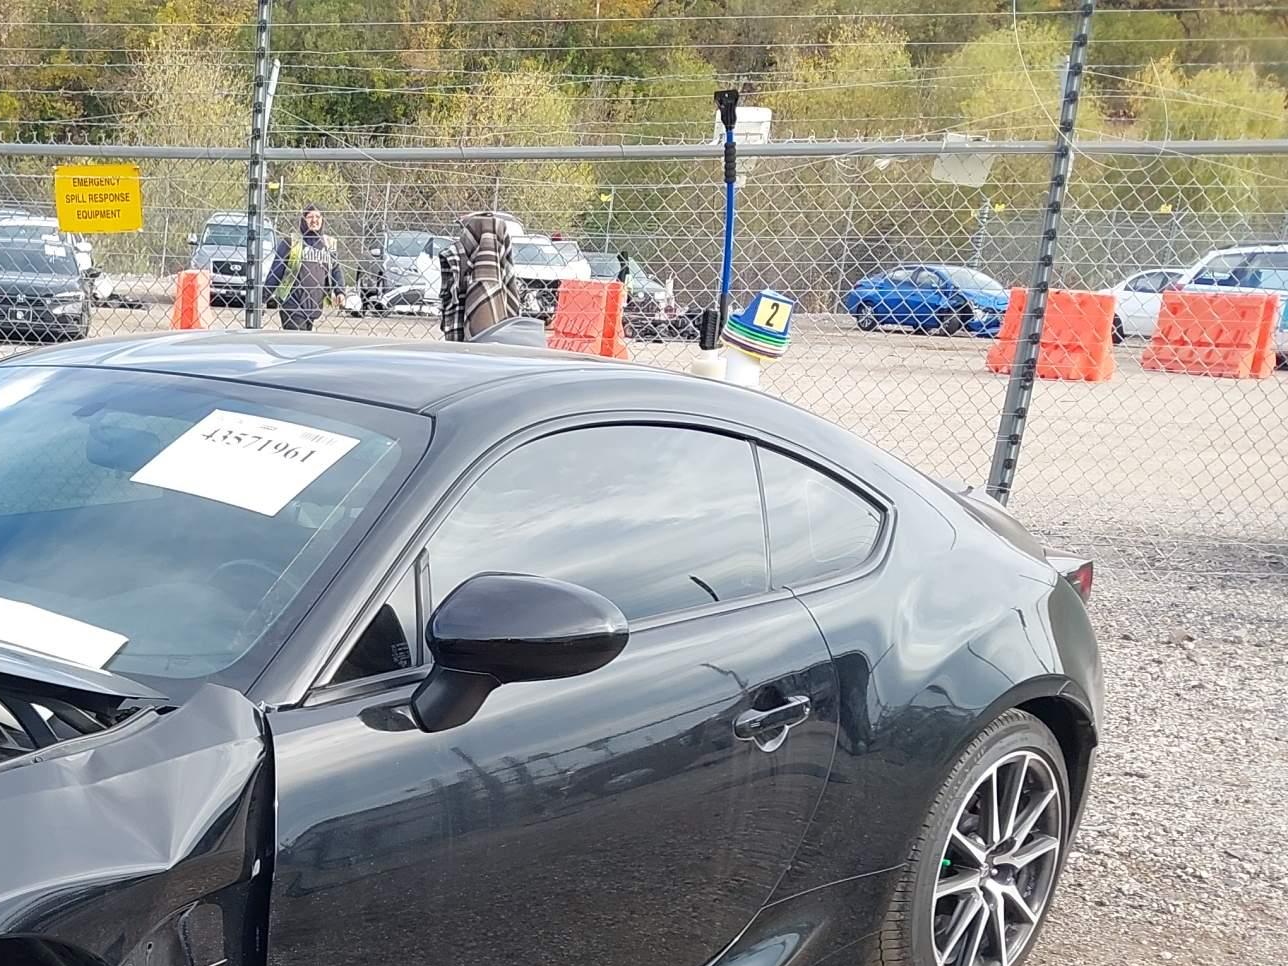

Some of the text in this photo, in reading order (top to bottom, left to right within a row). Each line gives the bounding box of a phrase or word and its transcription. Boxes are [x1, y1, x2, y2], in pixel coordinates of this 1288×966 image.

[72, 177, 120, 188] EMERGENCY
[65, 192, 131, 204] SPILL RESPONSE
[76, 208, 121, 219] EQUIPMENT
[765, 302, 780, 328] 2
[201, 427, 317, 463] 43571961
